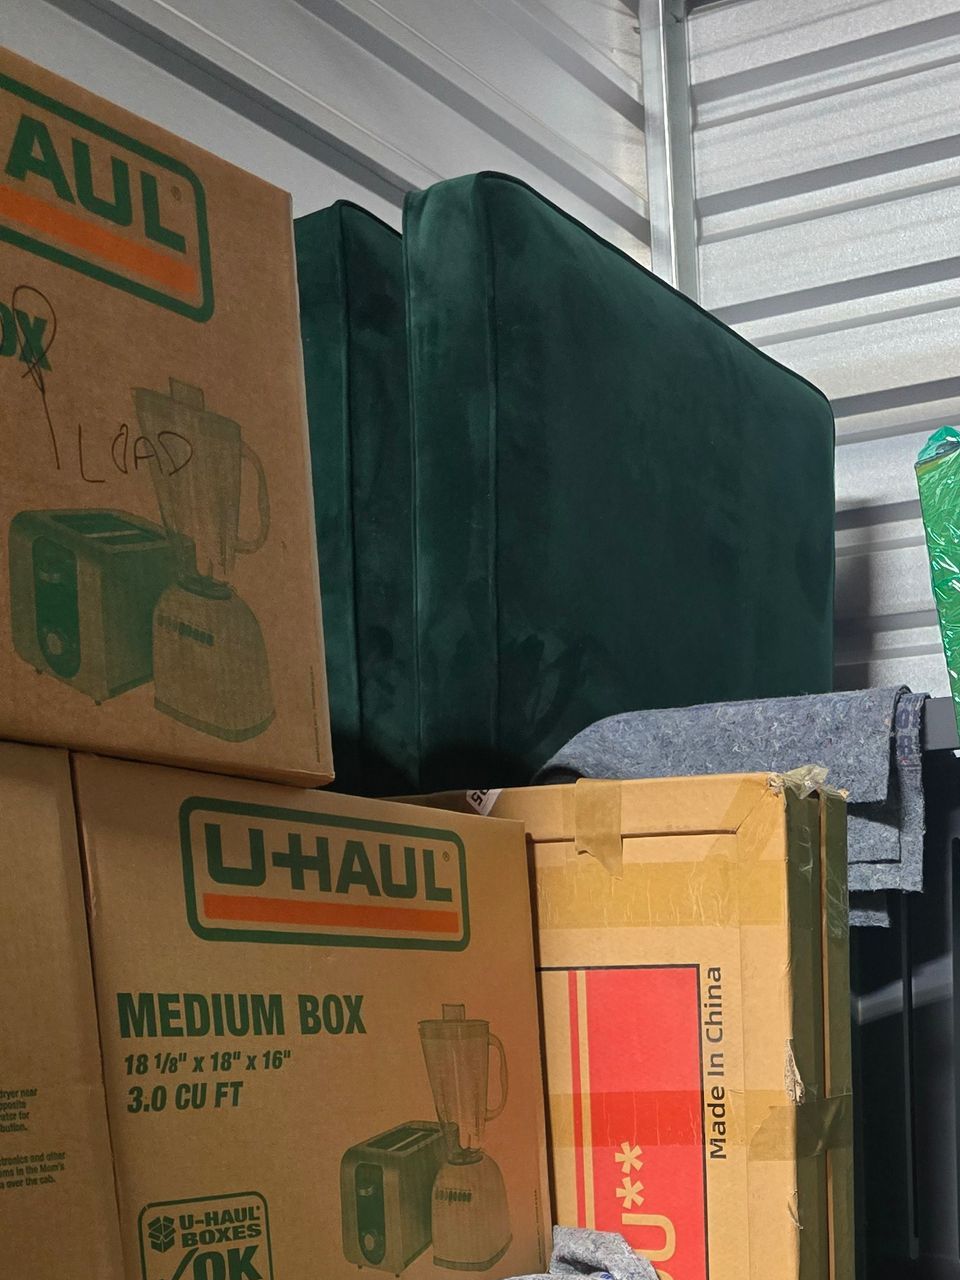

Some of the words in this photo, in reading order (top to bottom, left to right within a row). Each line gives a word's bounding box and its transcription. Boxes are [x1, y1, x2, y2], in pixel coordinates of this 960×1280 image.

[204, 823, 453, 902] U-HAUL
[117, 992, 285, 1038] MEDIUM
[298, 993, 367, 1035] BOX
[704, 966, 723, 1044] China
[707, 1052, 724, 1077] In
[127, 1085, 168, 1113] 3.0
[175, 1082, 208, 1110] CU
[214, 1081, 244, 1109] FT
[707, 1085, 727, 1160] Made
[179, 1207, 260, 1230] U-HAUL
[182, 1224, 262, 1248] BOXES
